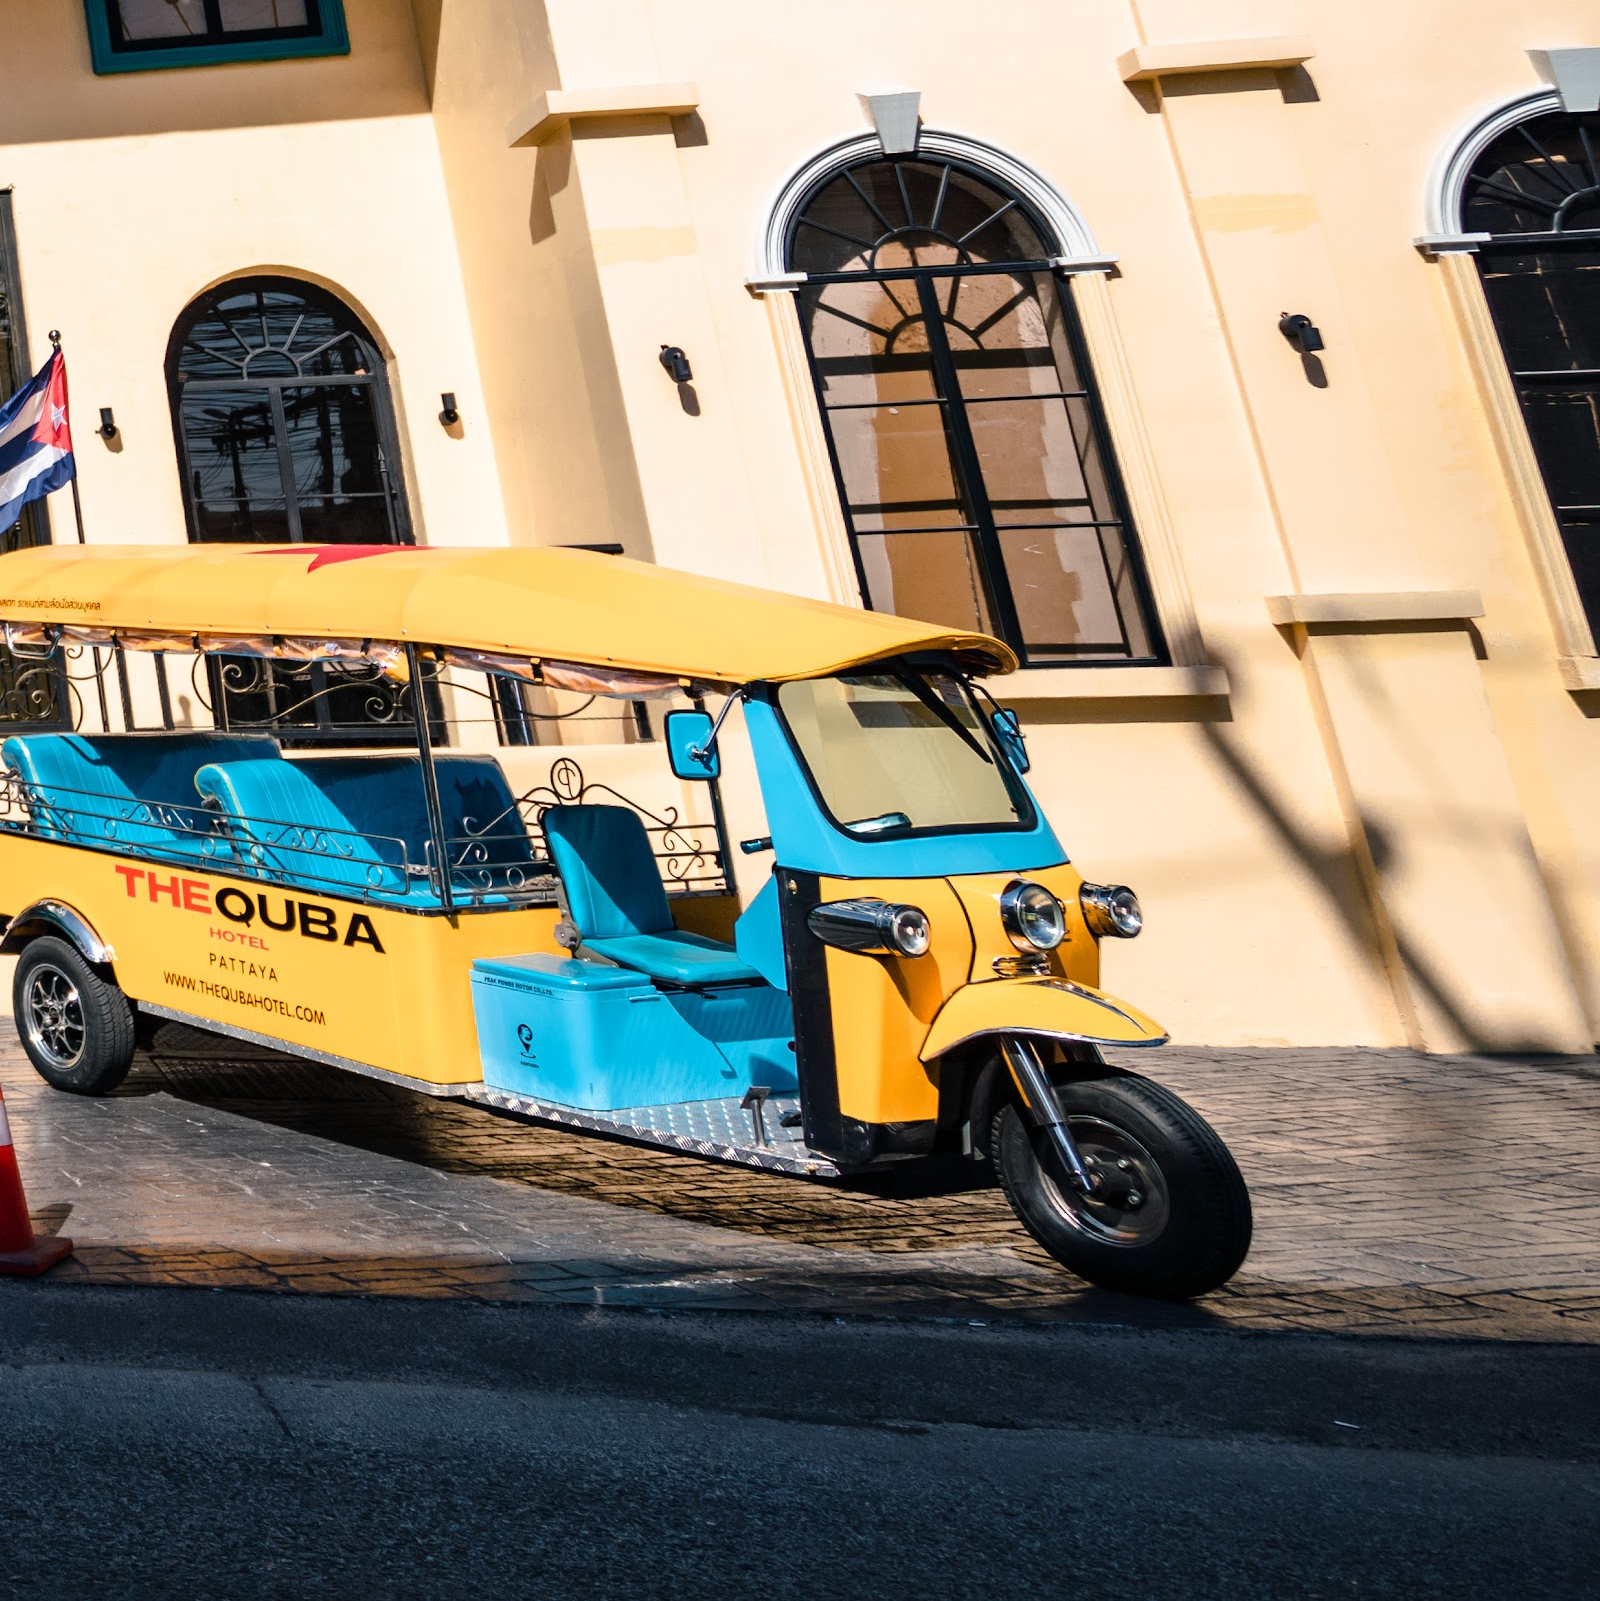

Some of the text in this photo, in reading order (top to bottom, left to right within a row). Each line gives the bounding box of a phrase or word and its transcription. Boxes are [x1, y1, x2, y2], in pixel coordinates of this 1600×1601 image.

[209, 926, 270, 951] HOTEL
[209, 952, 279, 983] PATTAYA
[484, 976, 497, 984] PEAK
[497, 979, 515, 988] POWER
[515, 982, 533, 992] MOTOR
[163, 970, 327, 1027] WWW.THEQUBAHOTEL.COM
